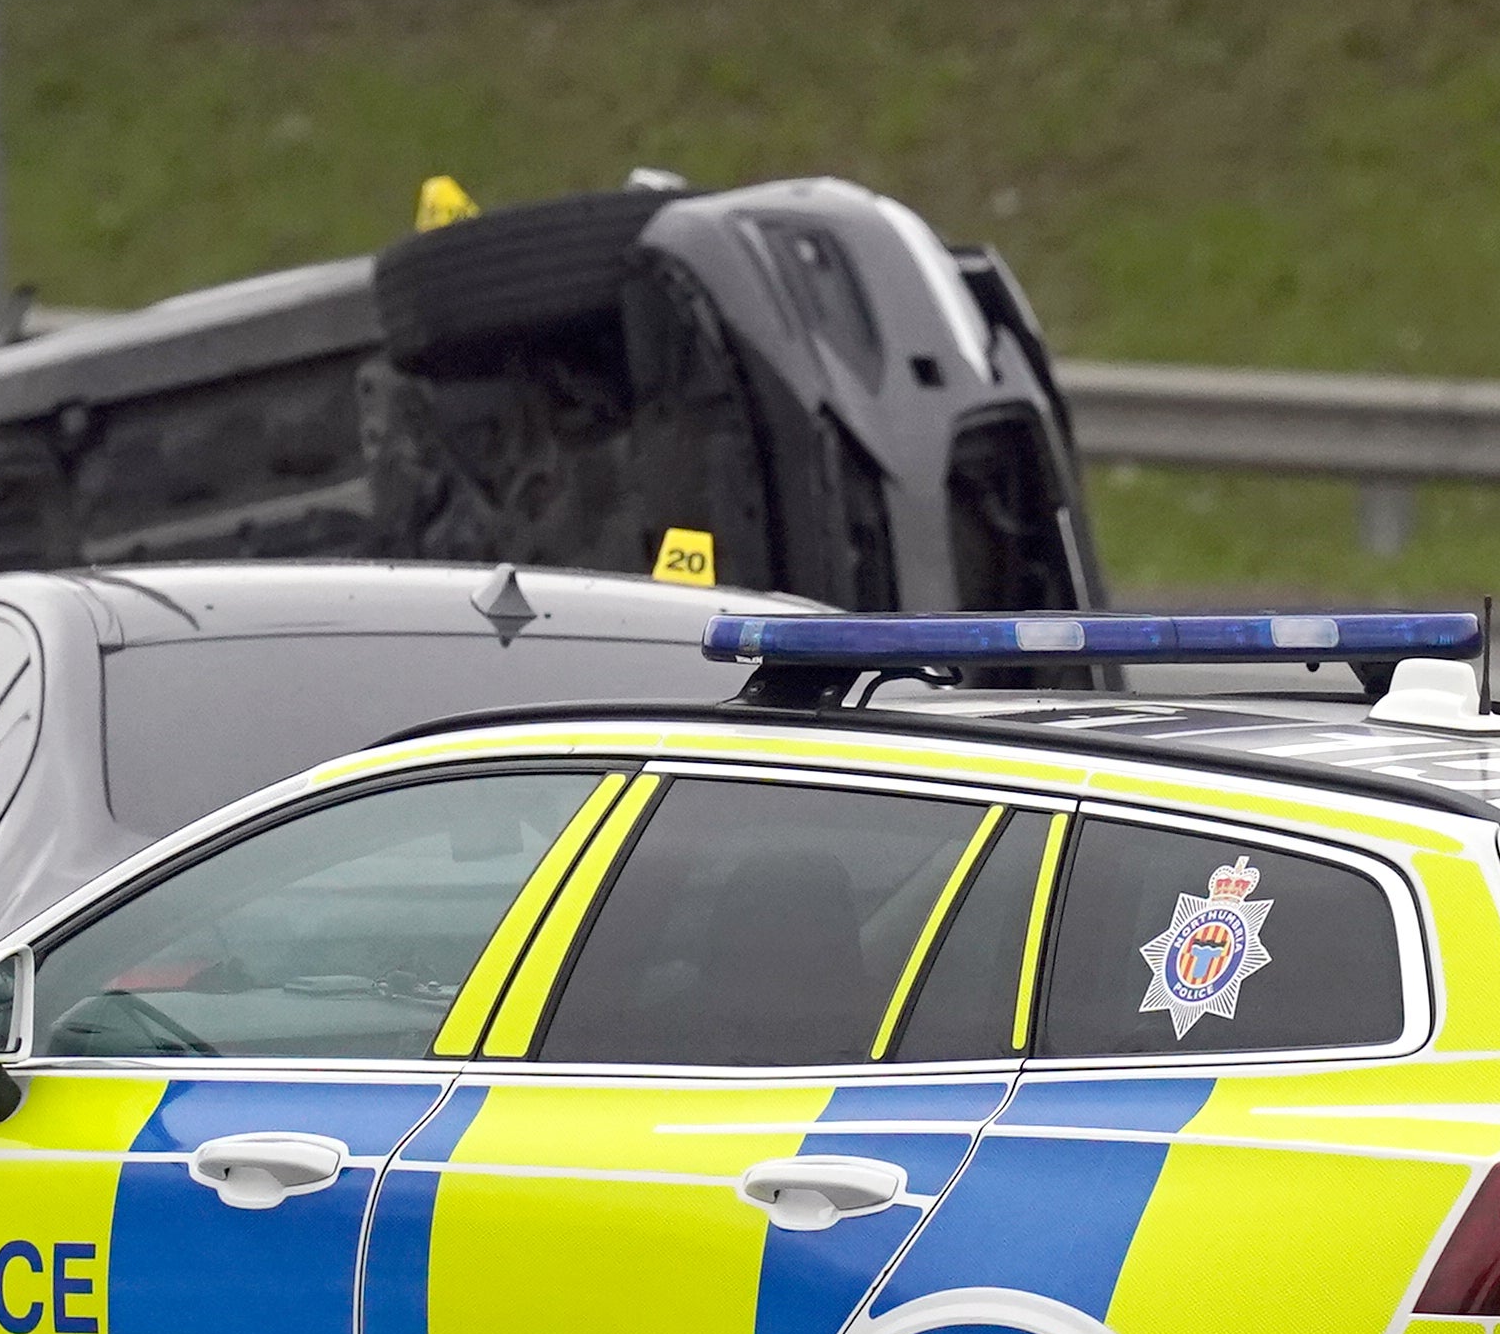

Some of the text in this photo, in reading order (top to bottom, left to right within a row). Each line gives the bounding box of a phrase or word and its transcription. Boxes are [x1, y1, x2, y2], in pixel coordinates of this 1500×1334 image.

[667, 549, 706, 573] 20
[1174, 909, 1244, 953] NORTHUMBRIA
[1172, 983, 1216, 1000] POLICE
